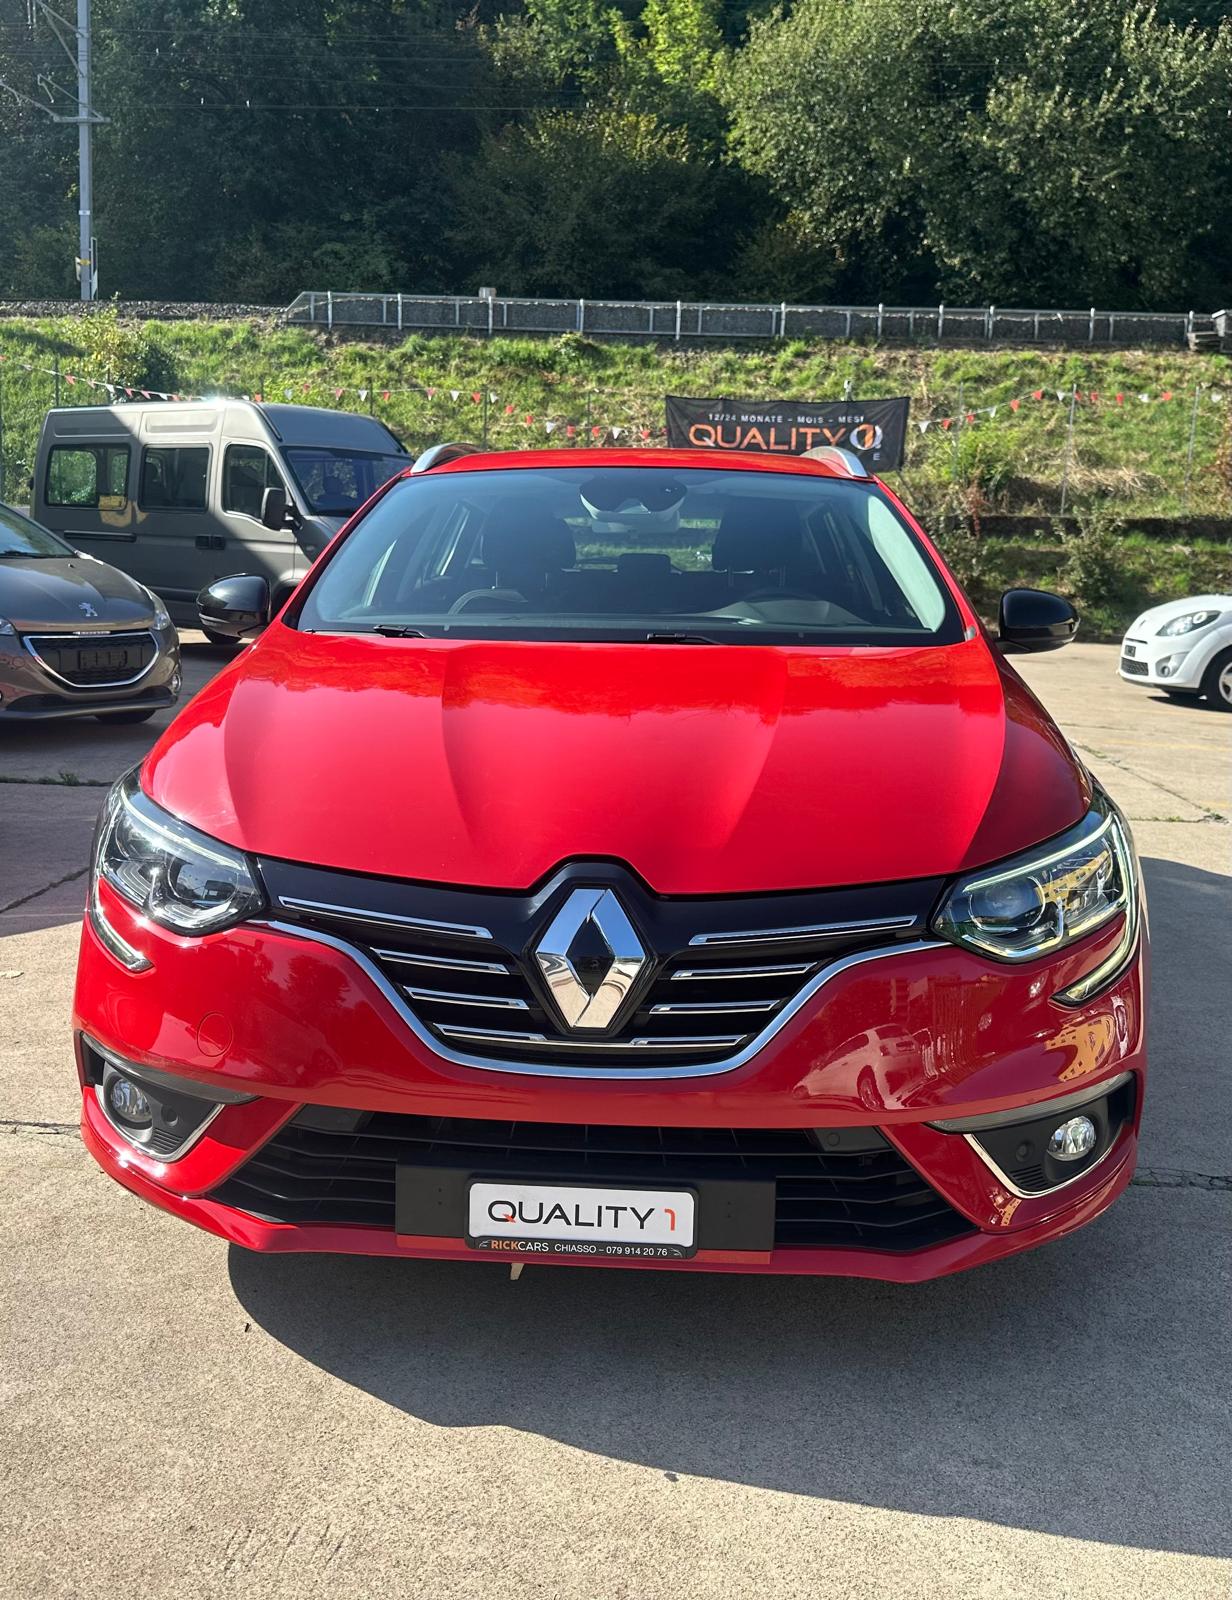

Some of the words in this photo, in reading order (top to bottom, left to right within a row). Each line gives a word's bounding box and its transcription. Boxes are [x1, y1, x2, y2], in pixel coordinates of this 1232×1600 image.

[708, 413, 737, 421] 12/24
[741, 415, 783, 423] MONATE
[797, 416, 824, 424] MOIS
[688, 424, 846, 450] QUALITY
[488, 1200, 655, 1229] QUALITY
[664, 1208, 676, 1231] 1
[491, 1240, 549, 1252] RICKCARS
[554, 1243, 597, 1253] CHIASSO
[606, 1246, 623, 1254] 079
[624, 1247, 641, 1255] 914
[643, 1247, 655, 1256] 20
[656, 1248, 668, 1256] 76
